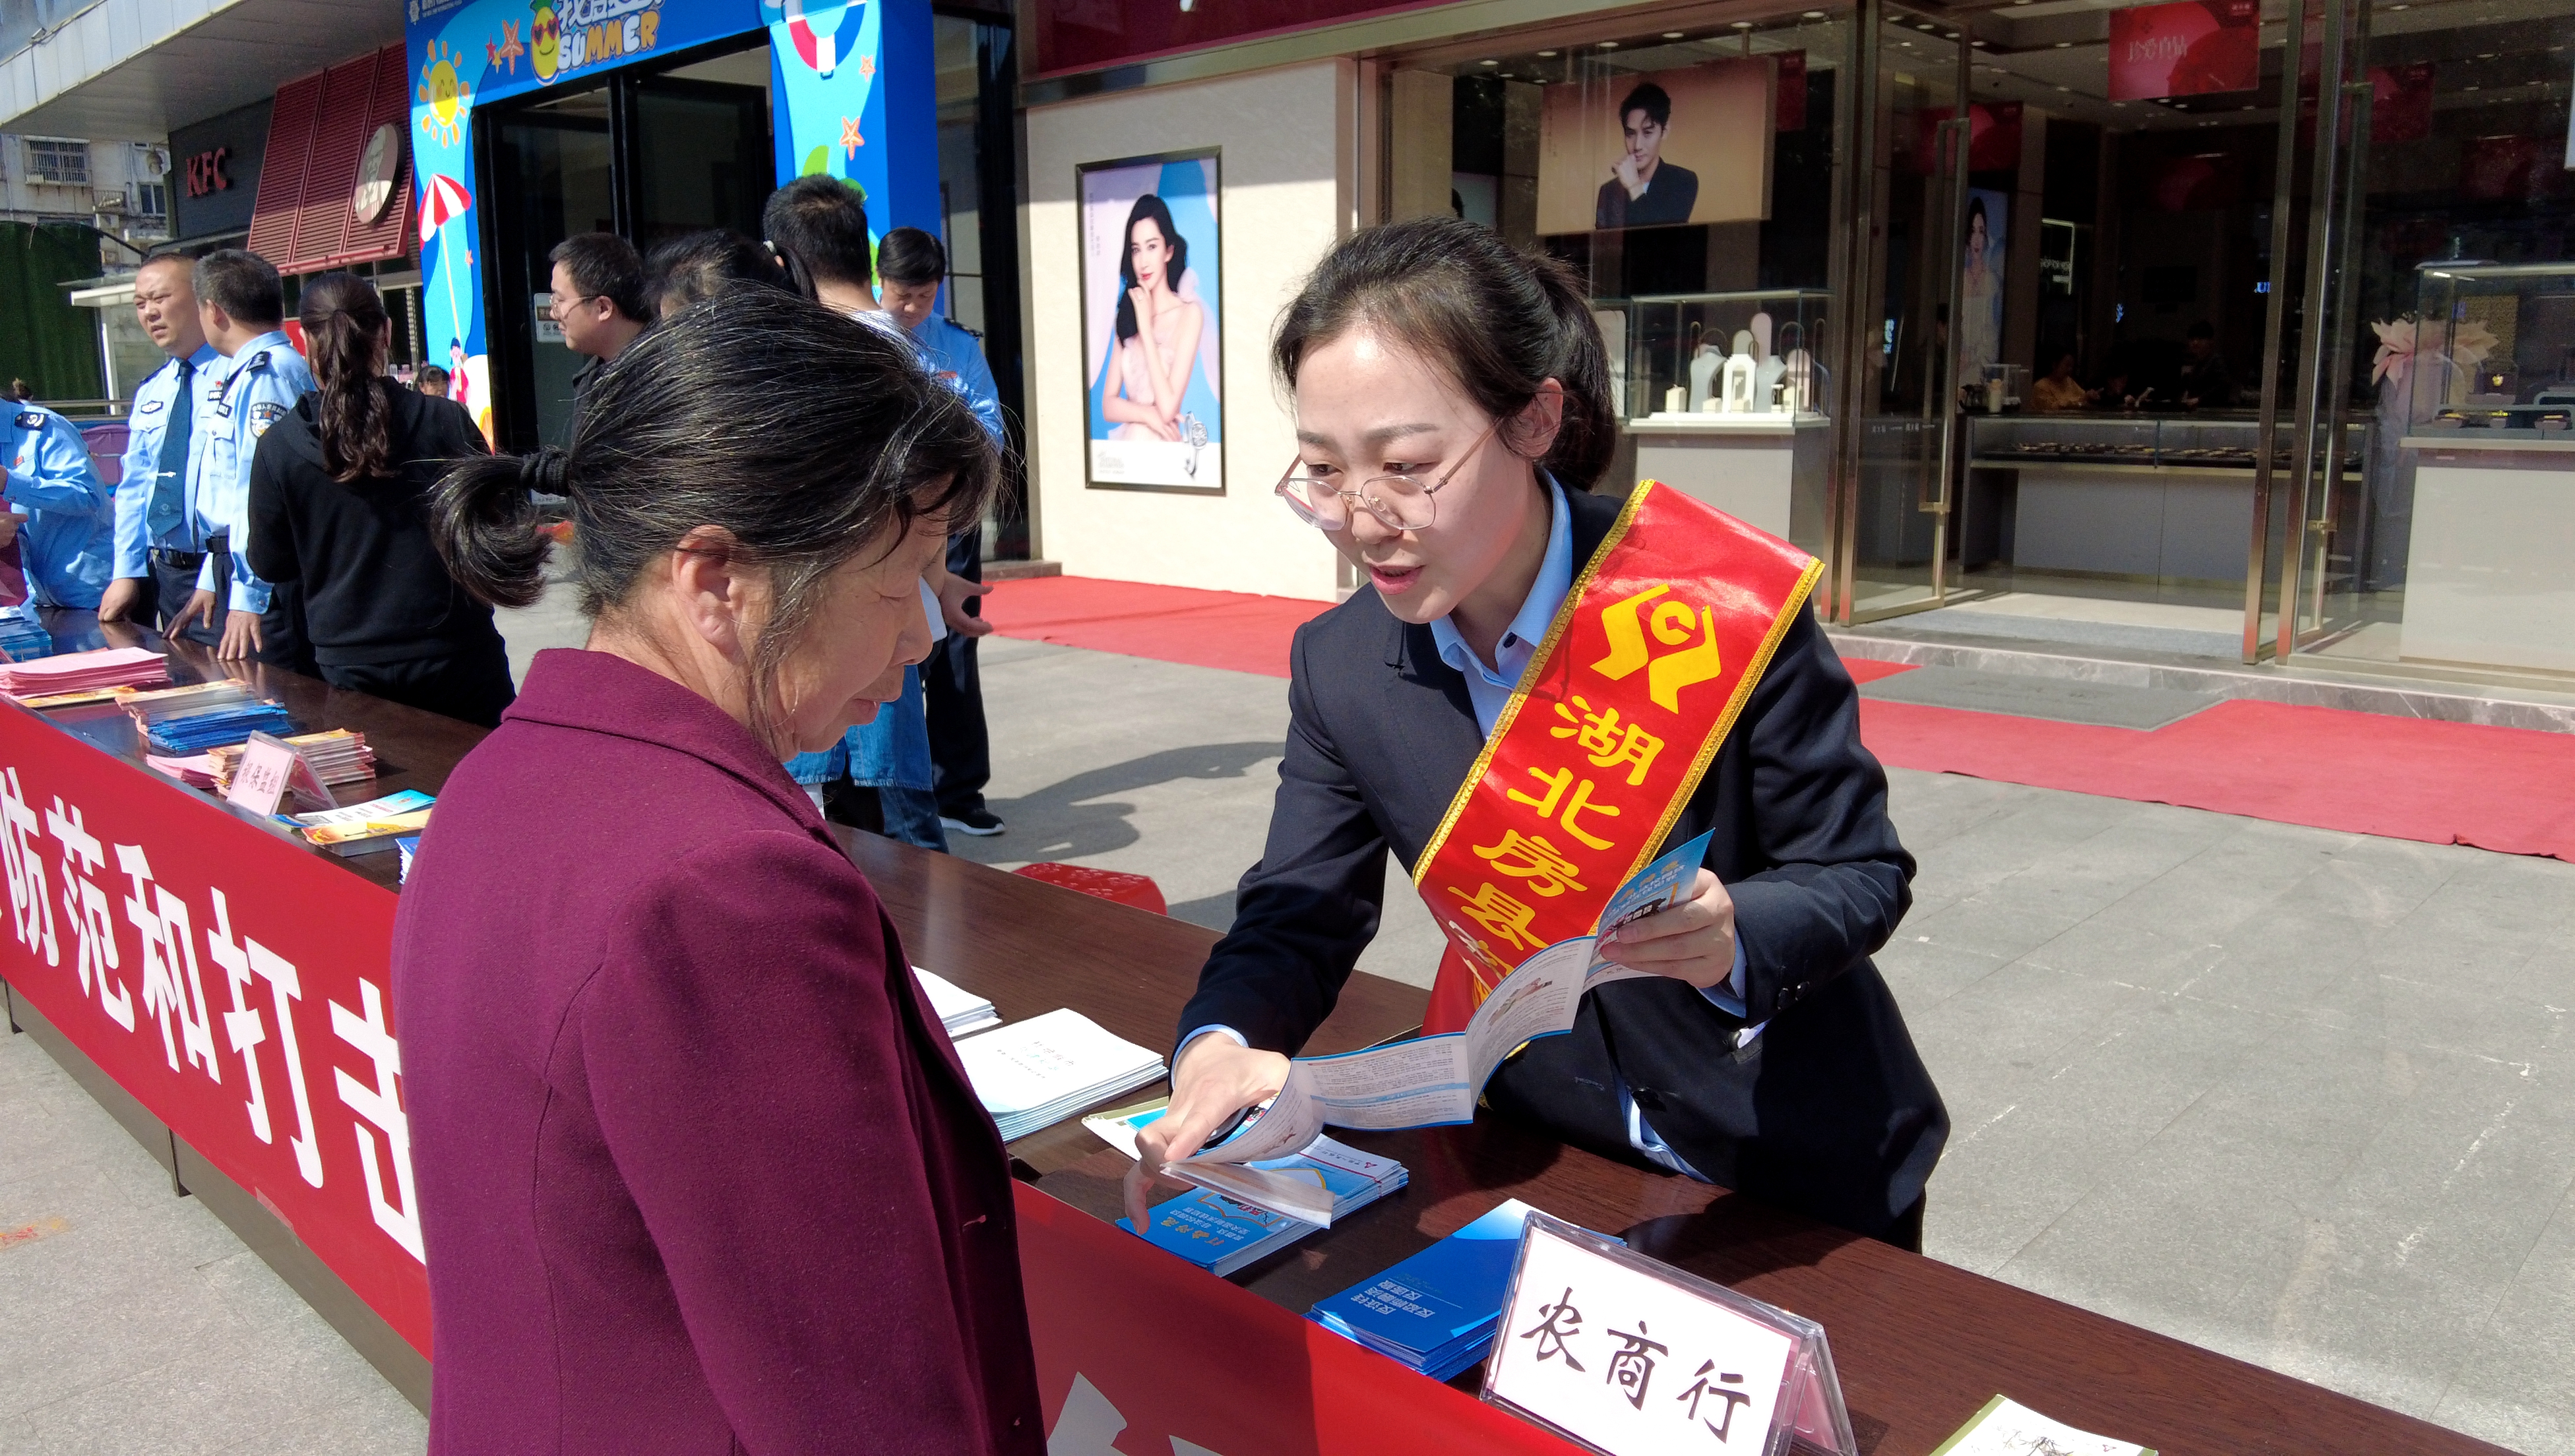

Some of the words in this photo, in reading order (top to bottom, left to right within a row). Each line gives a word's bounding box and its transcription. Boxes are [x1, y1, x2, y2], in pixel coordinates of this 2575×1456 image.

[558, 10, 659, 70] SUMMER
[186, 148, 227, 197] KFC
[0, 766, 426, 1265] 防范和打击
[1351, 1293, 1396, 1315] 反洗钱
[1520, 1286, 1751, 1443] 农商行
